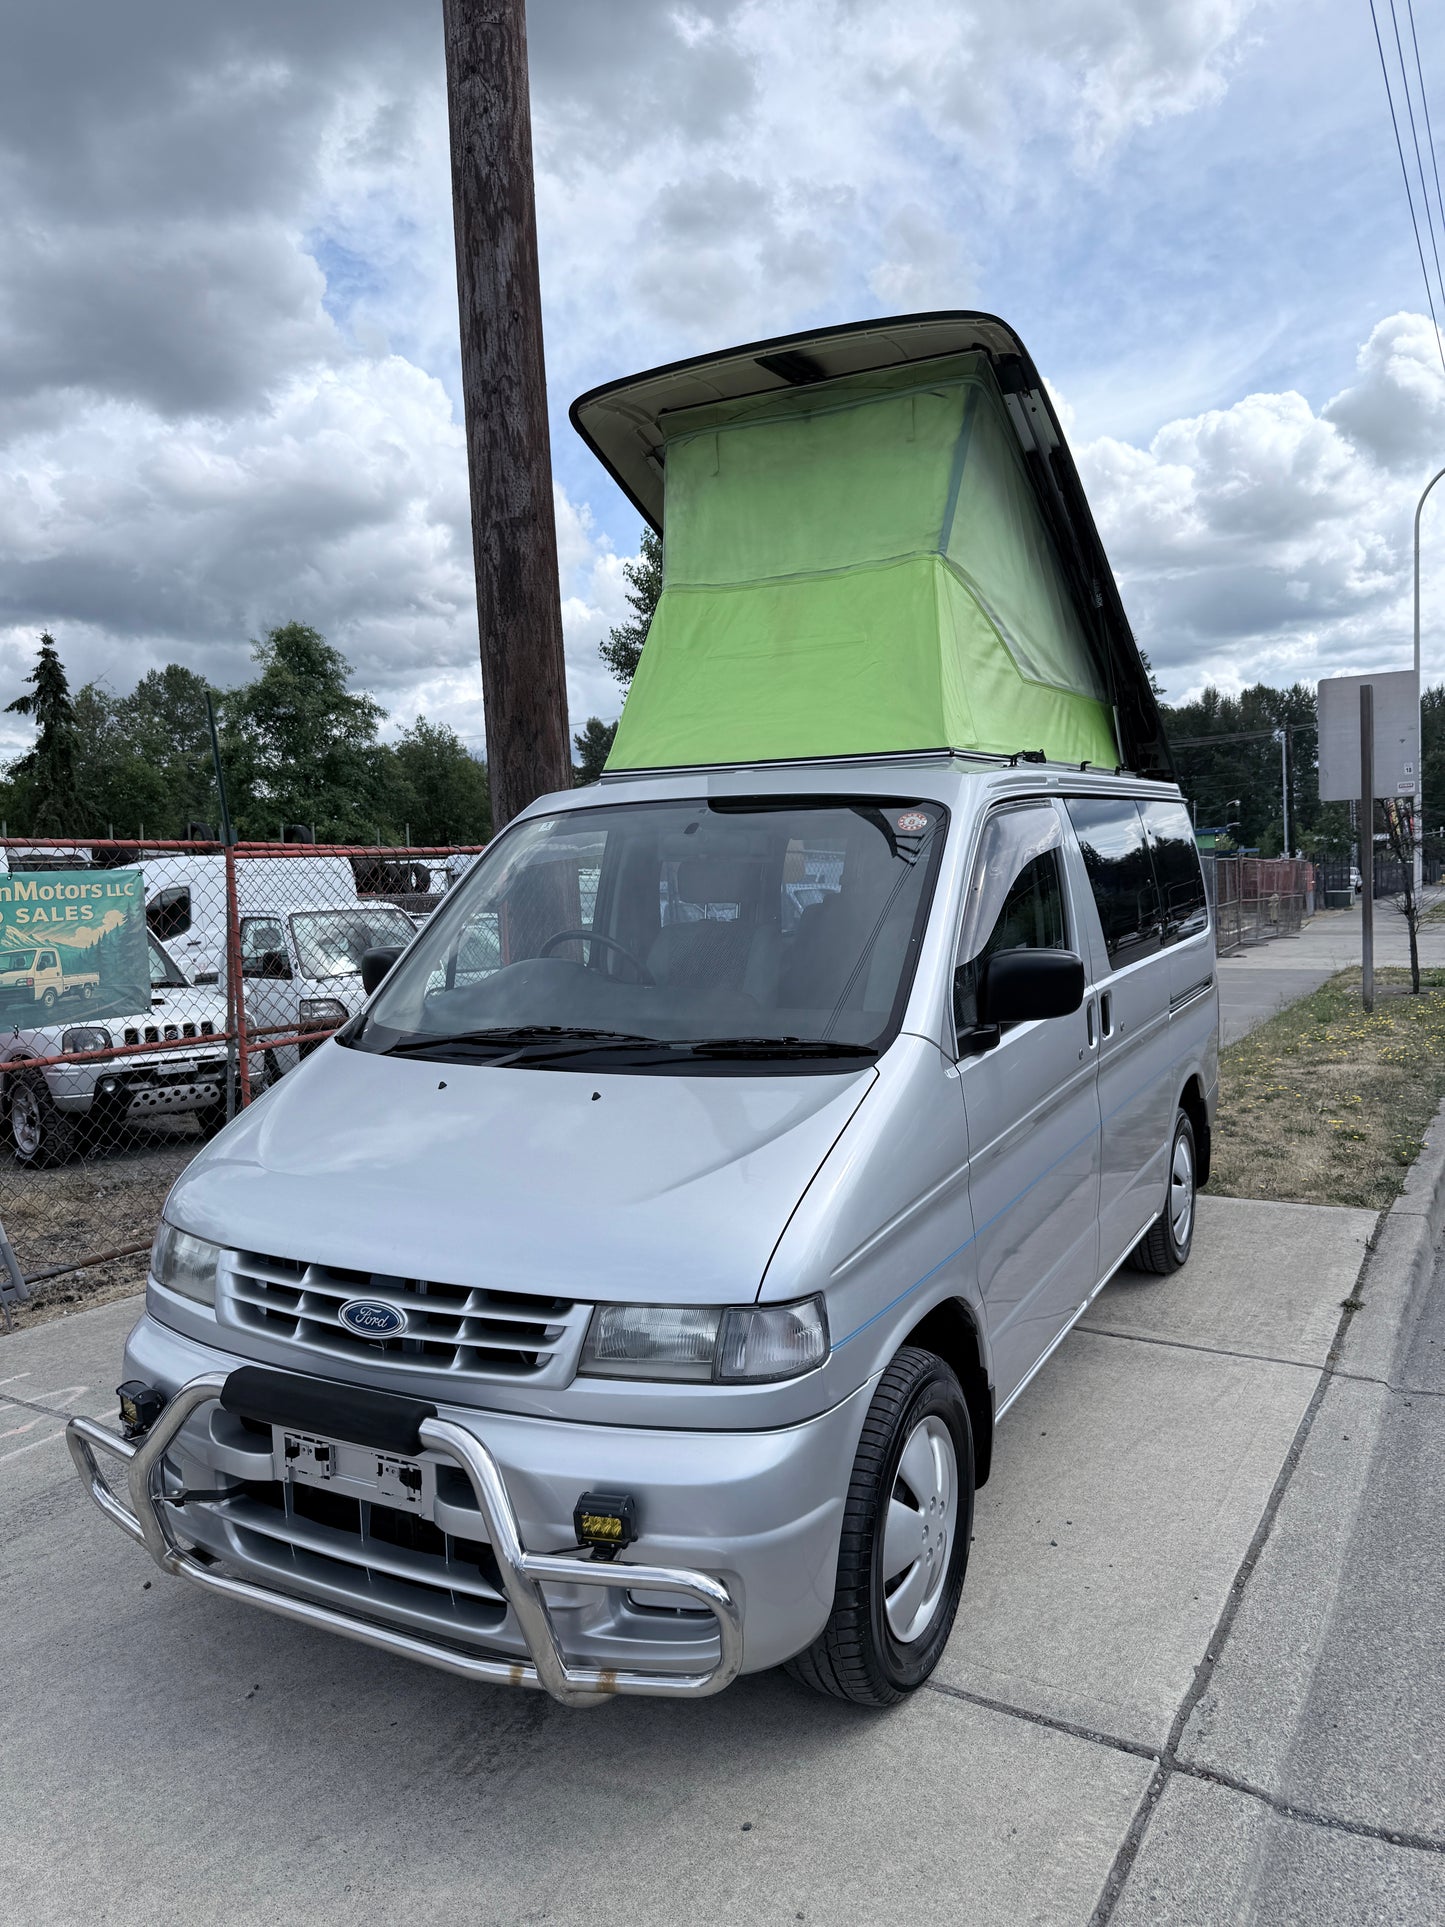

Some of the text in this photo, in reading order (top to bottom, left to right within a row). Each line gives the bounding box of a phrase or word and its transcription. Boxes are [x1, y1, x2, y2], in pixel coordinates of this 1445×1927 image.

[106, 883, 135, 897] LLC
[16, 905, 94, 924] SALES
[355, 1306, 390, 1328] Ford
